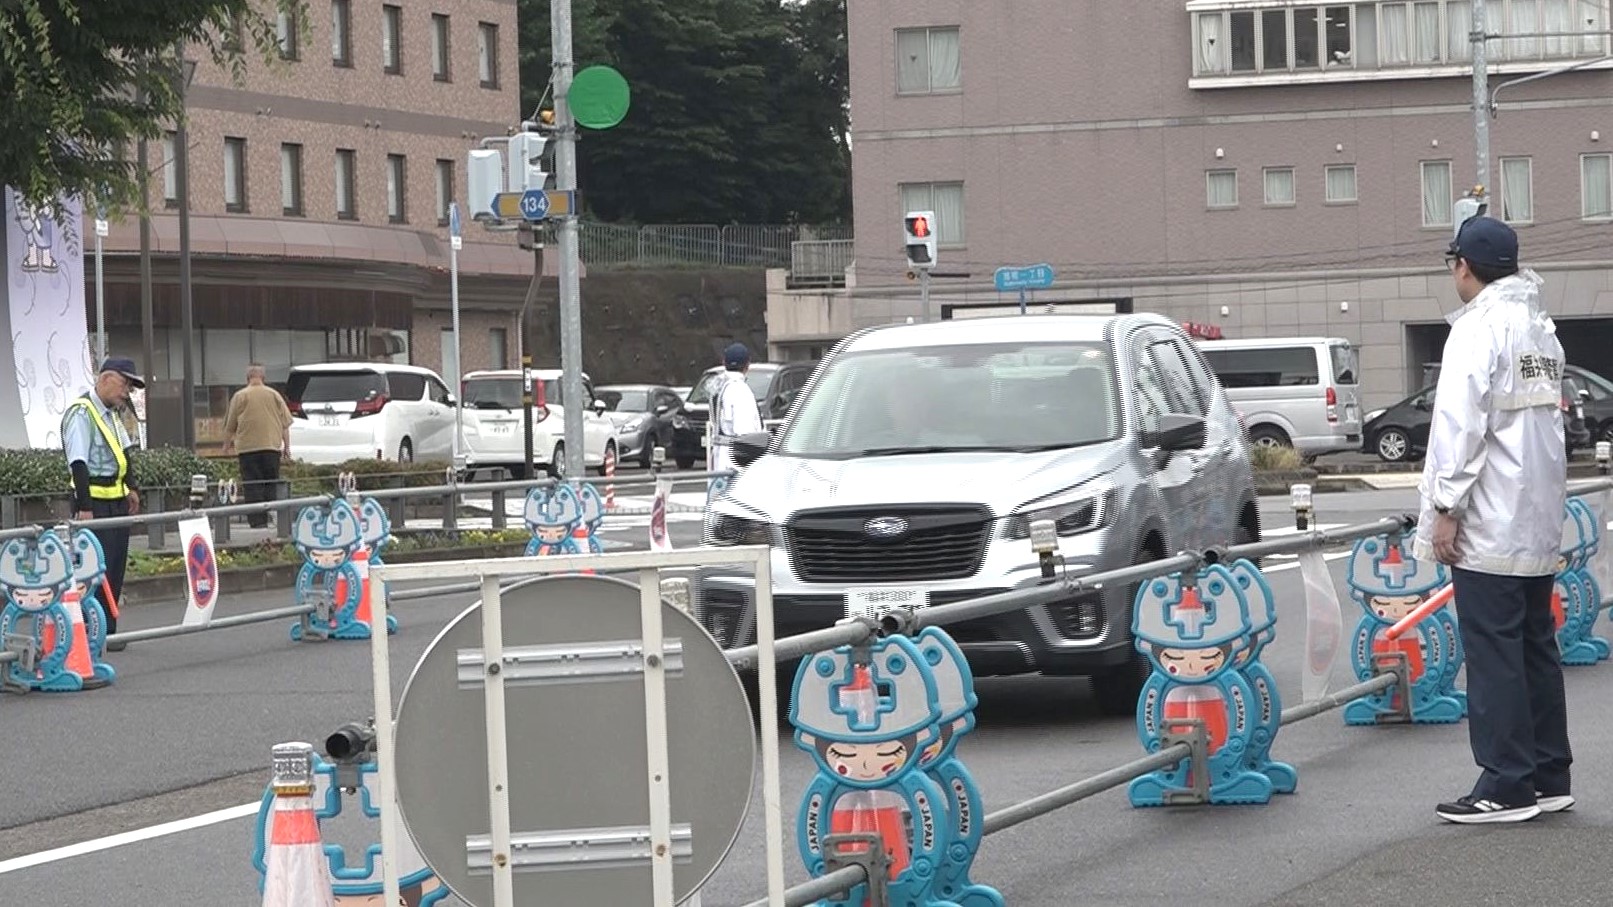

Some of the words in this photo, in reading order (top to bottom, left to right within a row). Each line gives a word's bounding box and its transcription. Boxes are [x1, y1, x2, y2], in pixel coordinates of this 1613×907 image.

[523, 196, 546, 213] 134
[1145, 702, 1155, 732] JAPAN
[1235, 698, 1244, 729] JAPAN
[1260, 691, 1270, 721] JAPAN
[921, 809, 932, 848] JAPAN
[958, 795, 969, 833] JAPAN
[807, 812, 819, 851] JAPAN
